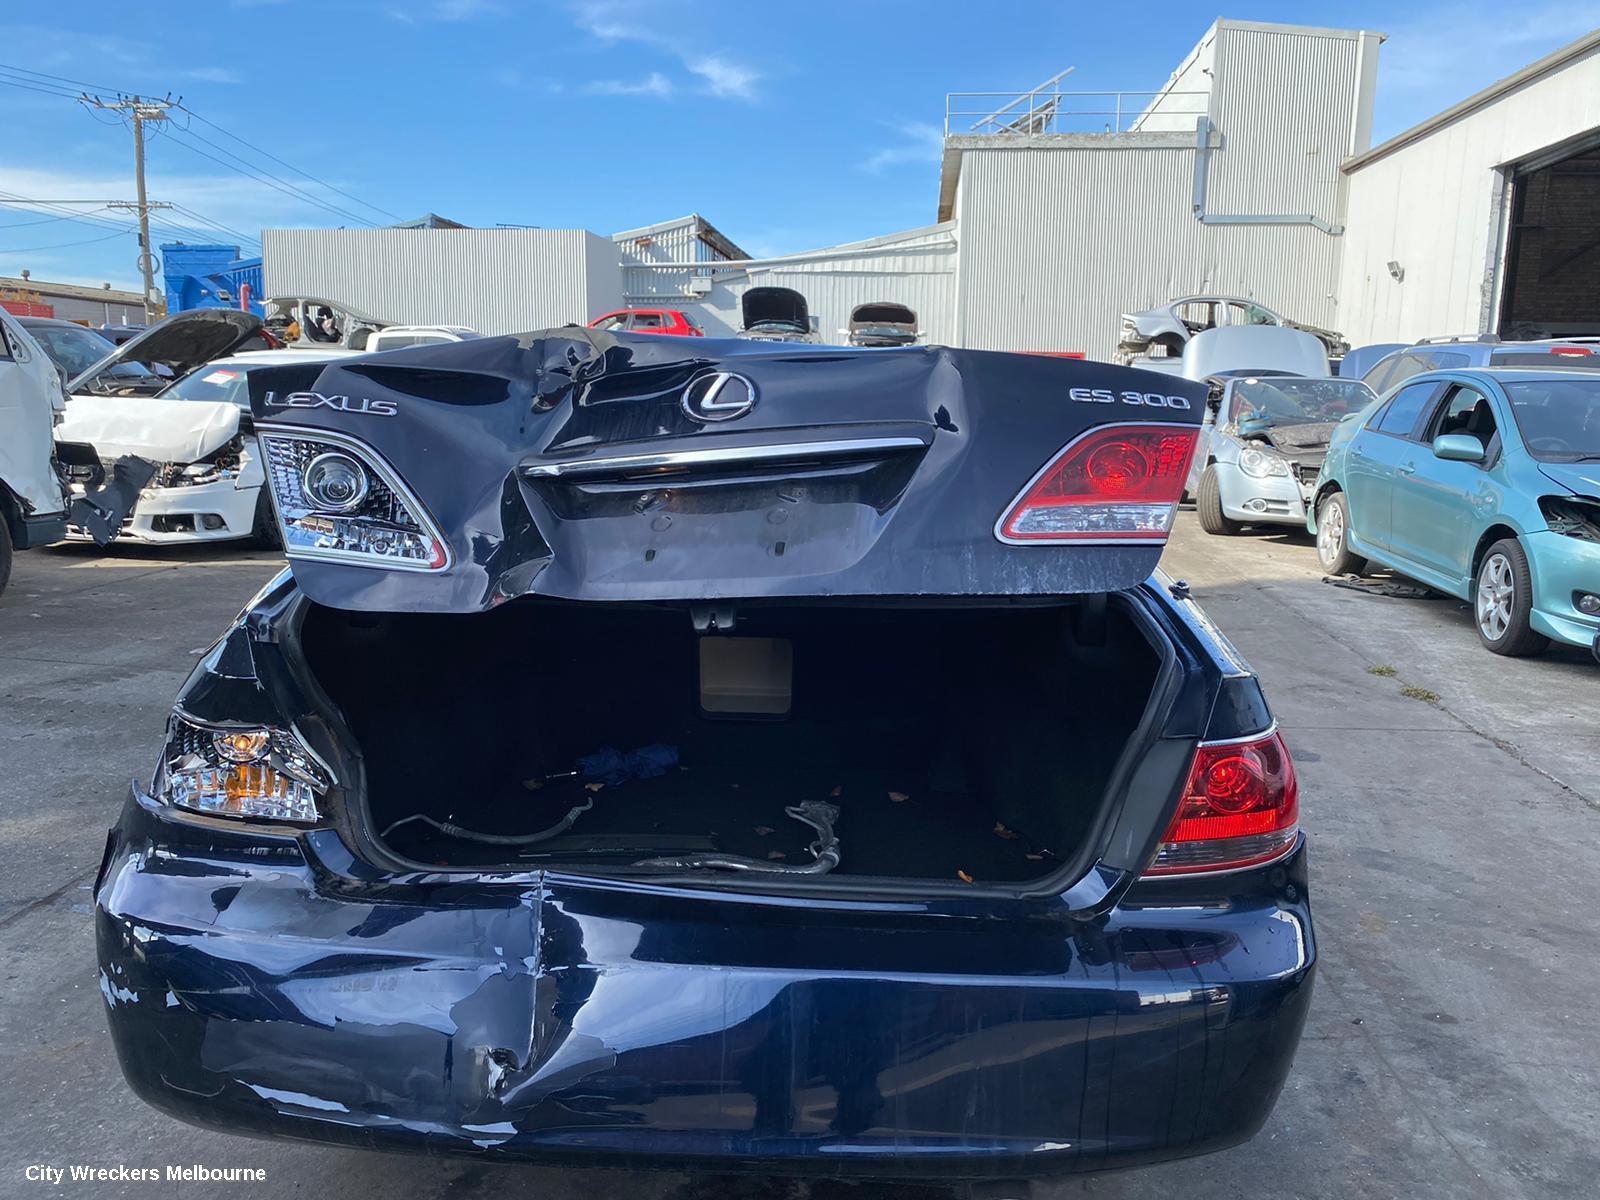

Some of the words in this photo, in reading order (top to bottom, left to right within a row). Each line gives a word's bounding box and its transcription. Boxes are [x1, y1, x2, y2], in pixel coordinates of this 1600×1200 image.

[264, 391, 398, 416] LEXUS
[1069, 387, 1115, 403] ES
[1120, 391, 1191, 409] 300
